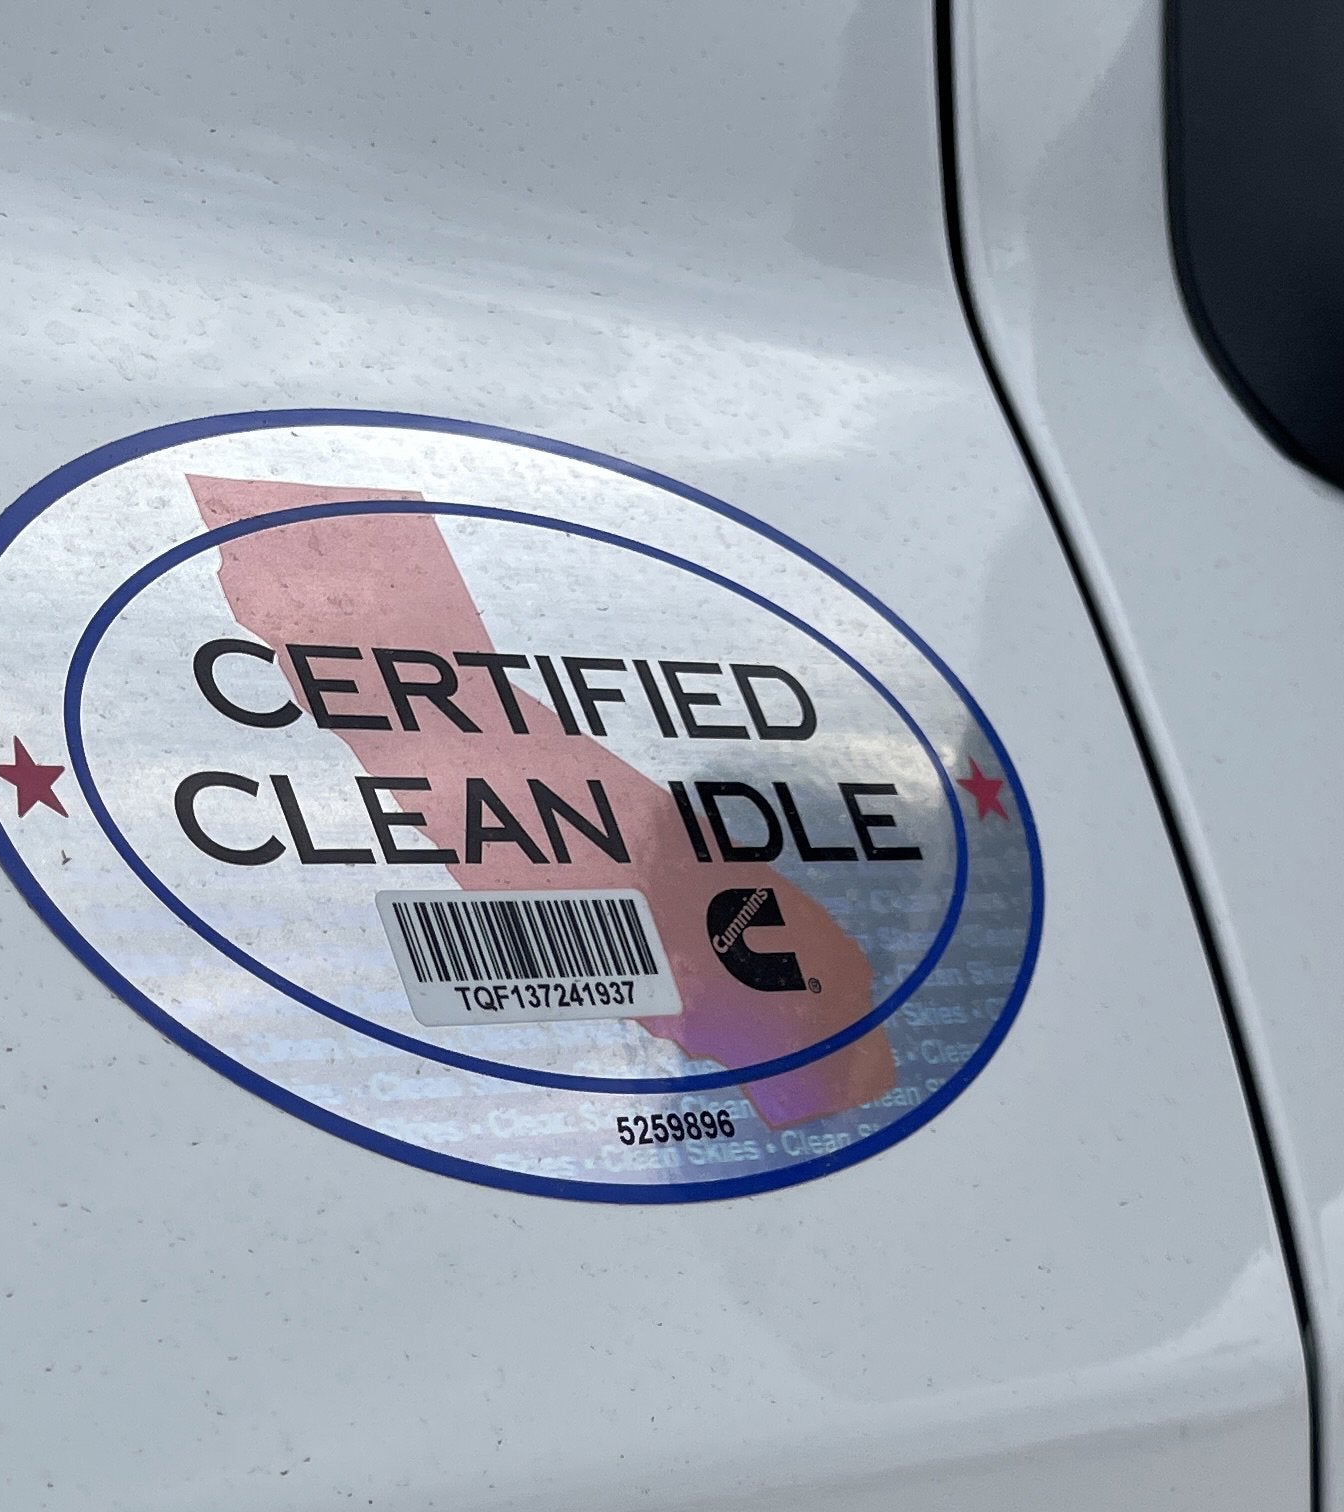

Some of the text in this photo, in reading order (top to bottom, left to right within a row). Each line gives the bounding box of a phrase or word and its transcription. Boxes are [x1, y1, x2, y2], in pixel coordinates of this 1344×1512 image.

[192, 638, 819, 741] CERTIFIED
[173, 770, 924, 866] CLEAN IDLE
[712, 888, 769, 954] Cummins
[454, 980, 635, 1012] TQF137241937
[616, 1109, 736, 1146] 5259896
